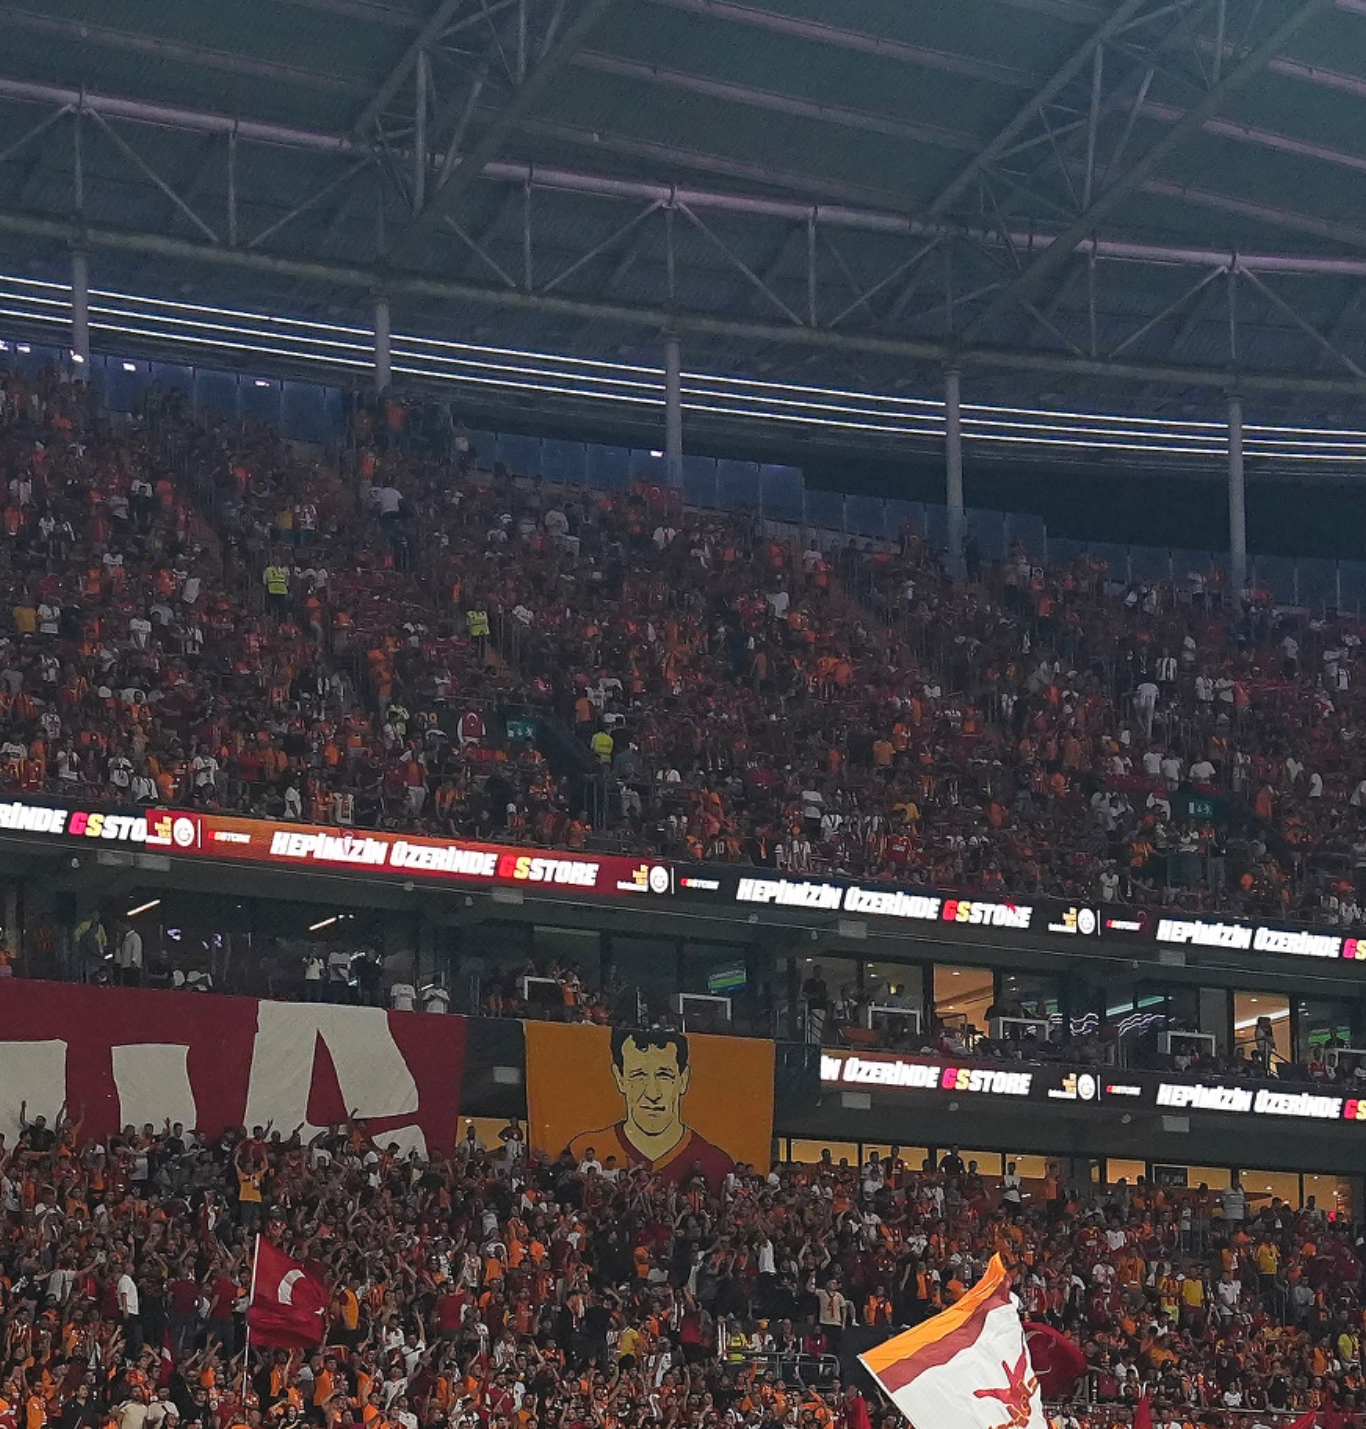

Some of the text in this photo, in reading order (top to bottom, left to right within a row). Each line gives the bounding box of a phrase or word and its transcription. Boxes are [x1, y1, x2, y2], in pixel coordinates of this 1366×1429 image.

[269, 831, 389, 865] HEPİMİZİN
[390, 840, 498, 877] ÜZERİNDE
[498, 855, 600, 888] GSSTORE
[736, 878, 843, 909] HEPİMİZİN
[844, 886, 941, 920] ÜZERİNDE
[942, 899, 1032, 929] GSSTORE
[1156, 919, 1253, 949] HEPİMİZİN
[1253, 926, 1342, 958] ÜZERİNDE
[842, 1057, 941, 1088] ÜZERİNDE
[941, 1068, 1032, 1095] GSSTORE
[1156, 1083, 1253, 1112] HEPİMİZİN
[1253, 1089, 1343, 1119] ÜZERİNDE
